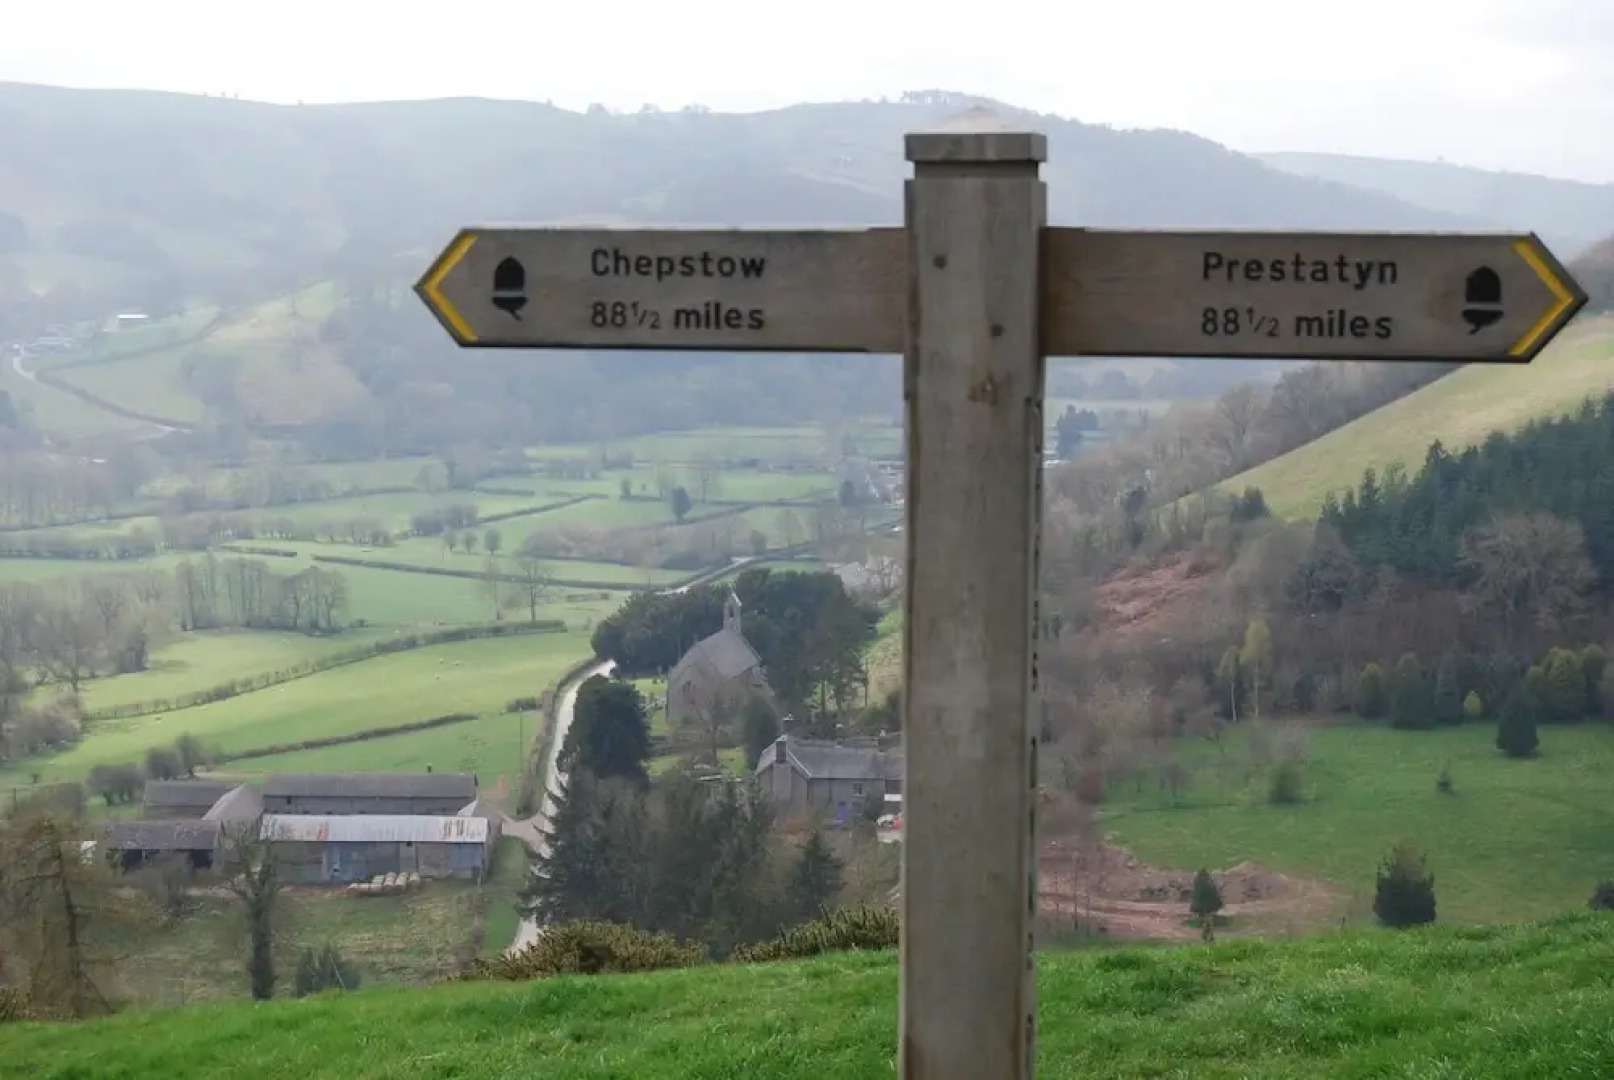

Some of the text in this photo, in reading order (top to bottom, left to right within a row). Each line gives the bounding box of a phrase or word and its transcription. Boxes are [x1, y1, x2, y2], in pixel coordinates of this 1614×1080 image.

[590, 247, 767, 283] Chepstow
[1202, 251, 1398, 291] Prestatyn
[673, 300, 767, 331] miles
[1295, 307, 1393, 340] miles
